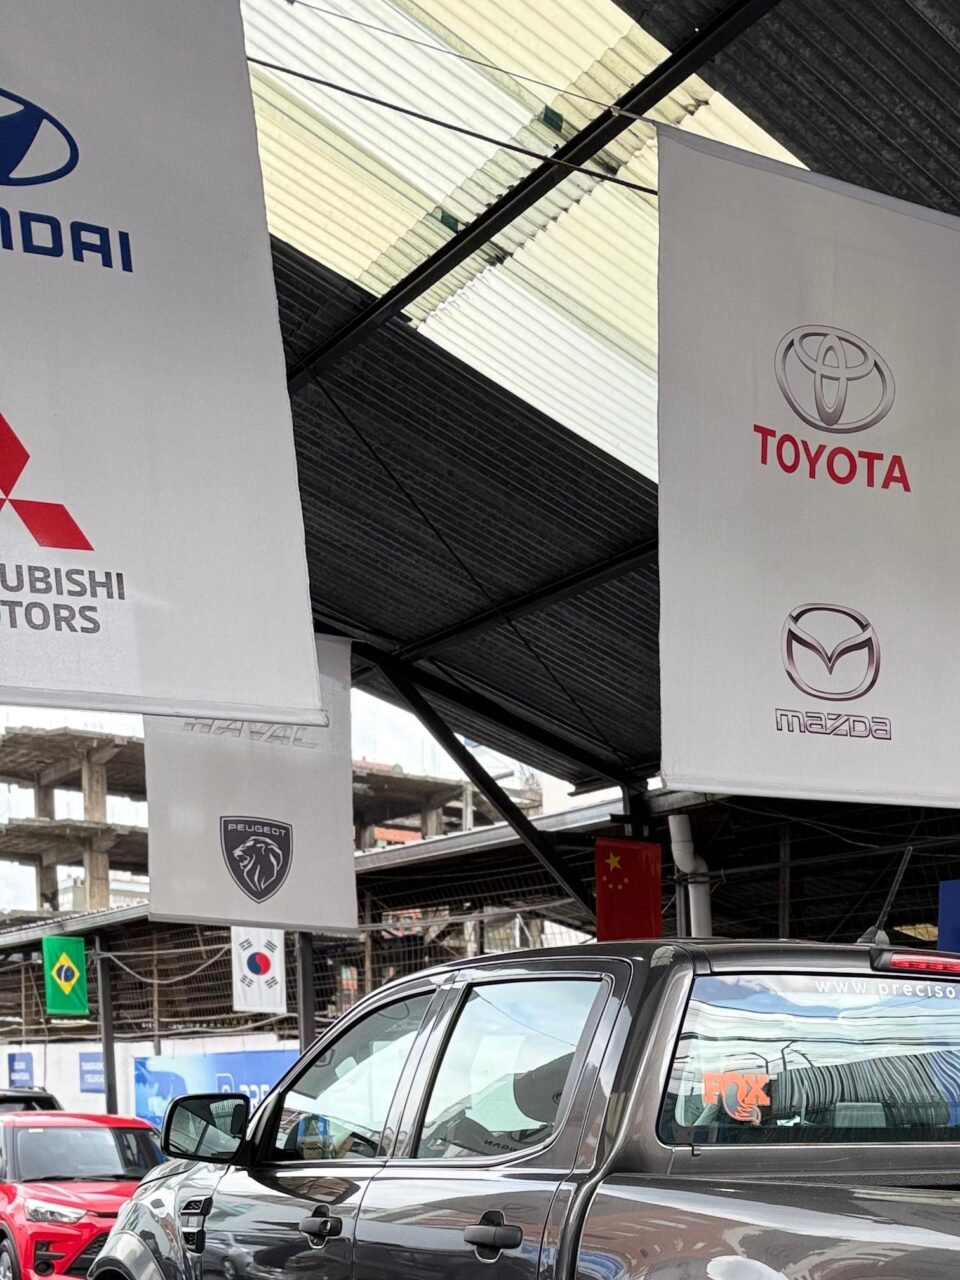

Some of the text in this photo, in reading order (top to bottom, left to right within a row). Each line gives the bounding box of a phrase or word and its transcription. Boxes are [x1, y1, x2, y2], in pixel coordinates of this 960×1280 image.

[753, 424, 911, 492] TOYOTA
[0, 600, 101, 634] TORS
[228, 823, 287, 838] PEUGEOT
[702, 1072, 771, 1127] FOX
